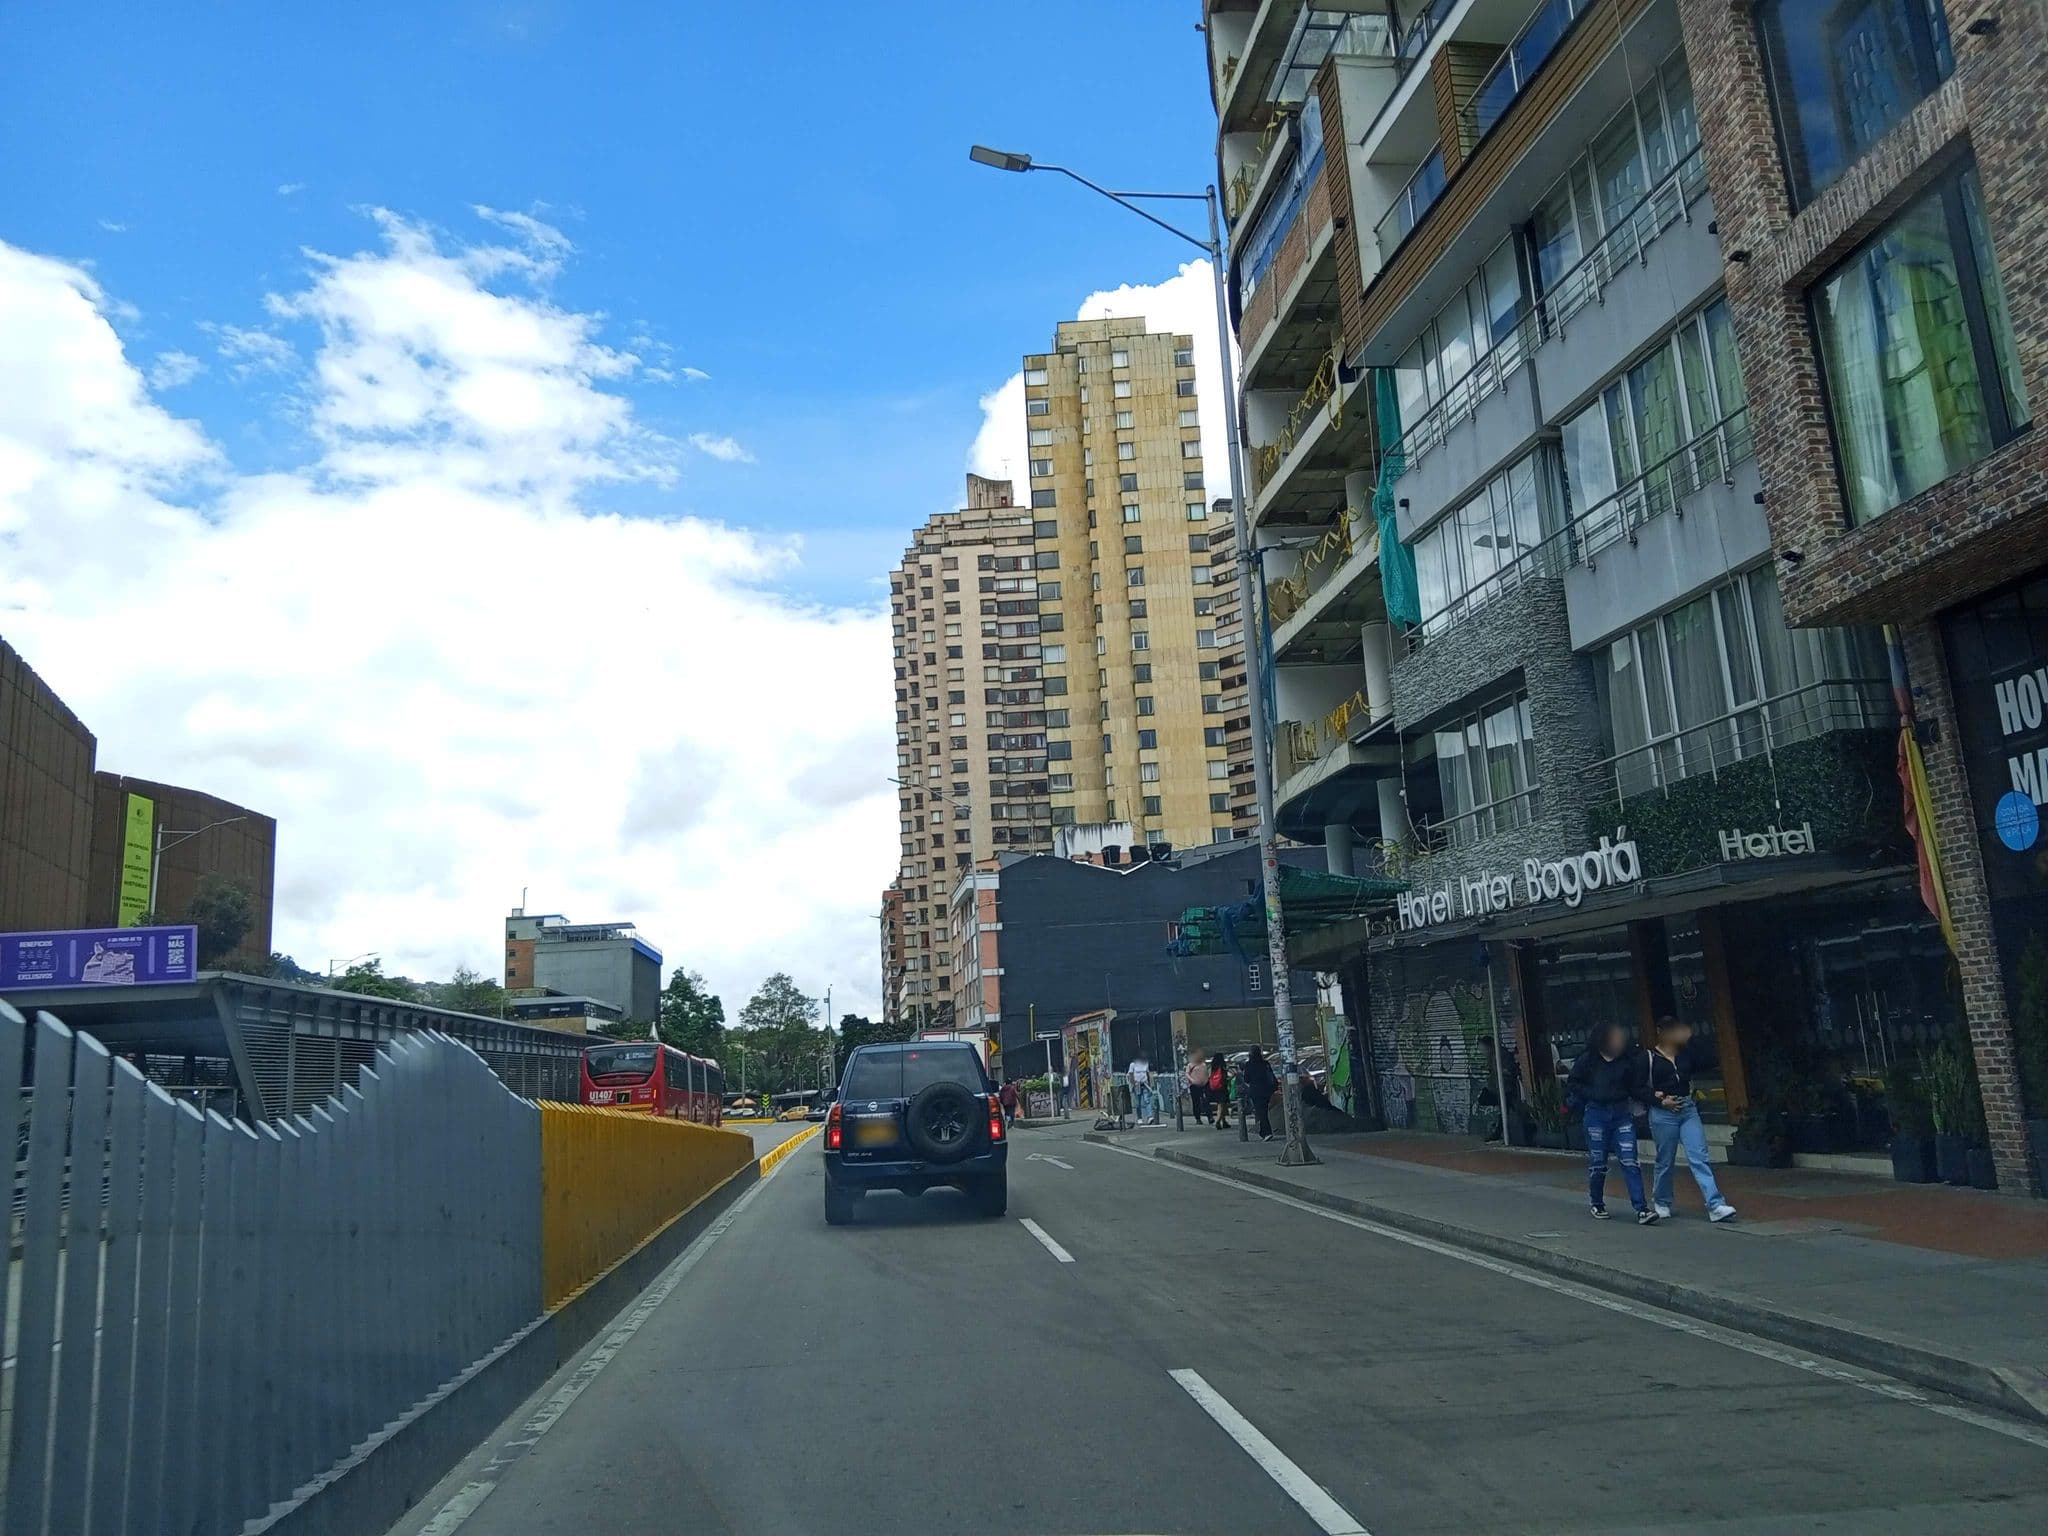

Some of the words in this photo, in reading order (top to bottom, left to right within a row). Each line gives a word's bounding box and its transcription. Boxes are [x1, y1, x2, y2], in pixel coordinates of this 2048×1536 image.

[1719, 822, 1815, 861] Hotel
[1396, 880, 1455, 931] Hotel
[1460, 869, 1516, 917] Inter
[1523, 825, 1642, 908] Bogotá
[168, 939, 185, 948] MÁS
